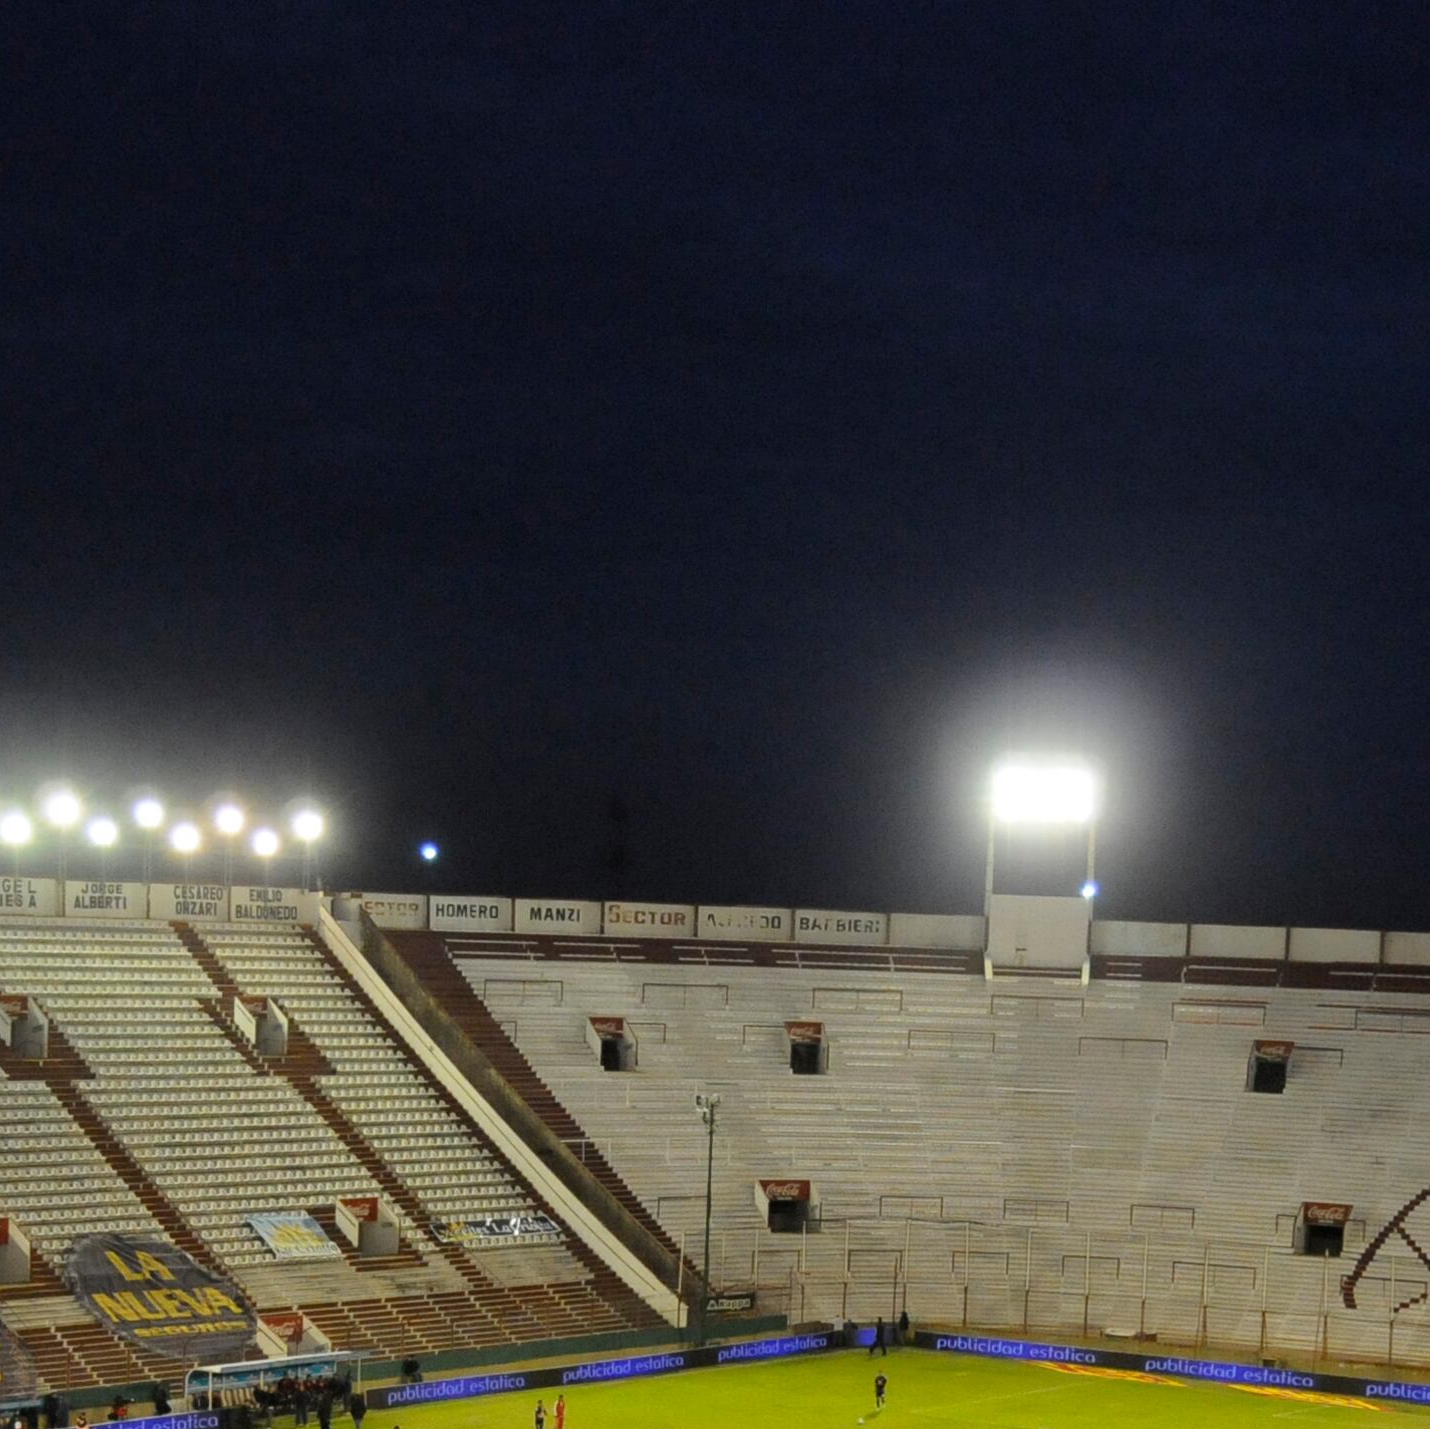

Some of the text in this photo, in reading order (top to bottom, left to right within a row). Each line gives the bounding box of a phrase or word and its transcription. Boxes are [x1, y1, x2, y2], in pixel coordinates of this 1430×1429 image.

[81, 882, 123, 895] JORGE
[173, 885, 223, 900] CESAREO
[73, 895, 128, 909] ALBERTI
[175, 901, 218, 917] ONZARI
[435, 903, 499, 919] HOMERO
[529, 906, 581, 922] MANZI
[608, 904, 687, 926] SECTOR
[105, 1250, 177, 1281] LA
[91, 1286, 244, 1323] NUEVA
[936, 1335, 1096, 1364] publicidad estatica
[562, 1353, 685, 1385] publicidad estatica
[1144, 1356, 1237, 1381] publicidad
[1243, 1369, 1314, 1388] estatica
[387, 1373, 526, 1406] publicidad estatica
